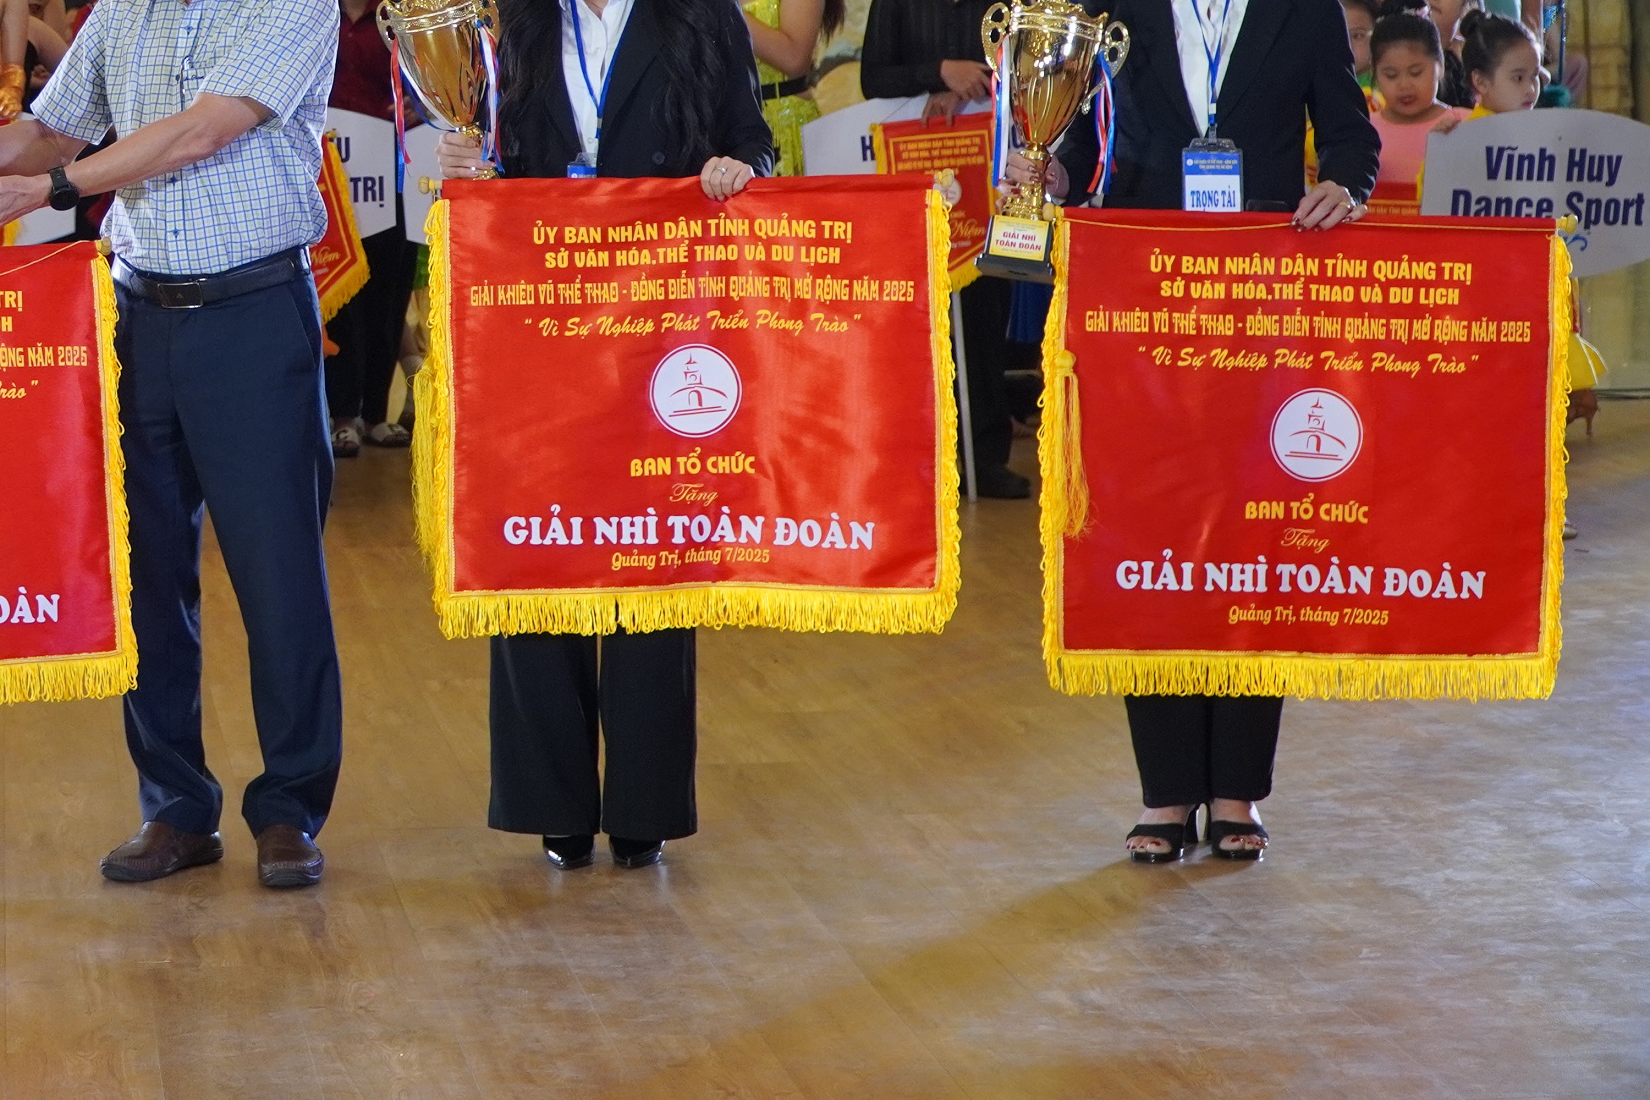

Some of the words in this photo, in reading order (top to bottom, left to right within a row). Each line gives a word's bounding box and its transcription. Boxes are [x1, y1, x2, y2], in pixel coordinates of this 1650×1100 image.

[1485, 145, 1556, 182] Vĩnh
[1566, 148, 1622, 187] Huy
[350, 176, 384, 207] TRỊ
[1191, 190, 1219, 211] TRỌNG
[1221, 185, 1235, 207] TÀI
[1451, 189, 1553, 217] Dance
[1565, 191, 1644, 230] Sport
[28, 341, 54, 367] NĂM
[58, 347, 88, 367] 2025
[630, 457, 672, 477] BAN
[676, 447, 701, 475] TỔ
[706, 450, 756, 474] CHỨC
[1244, 499, 1285, 520] BAN
[1289, 492, 1314, 520] TỔ
[1319, 500, 1368, 524] CHỨC
[503, 504, 582, 546] GIẢI
[593, 507, 660, 545] NHÌ
[667, 506, 765, 545] TOÀN
[774, 512, 875, 550] ĐOÀN
[1116, 548, 1194, 592] GIẢI
[1205, 555, 1268, 592] NHÌ
[1276, 557, 1374, 595] TOÀN
[1383, 561, 1486, 600] ĐOÀN
